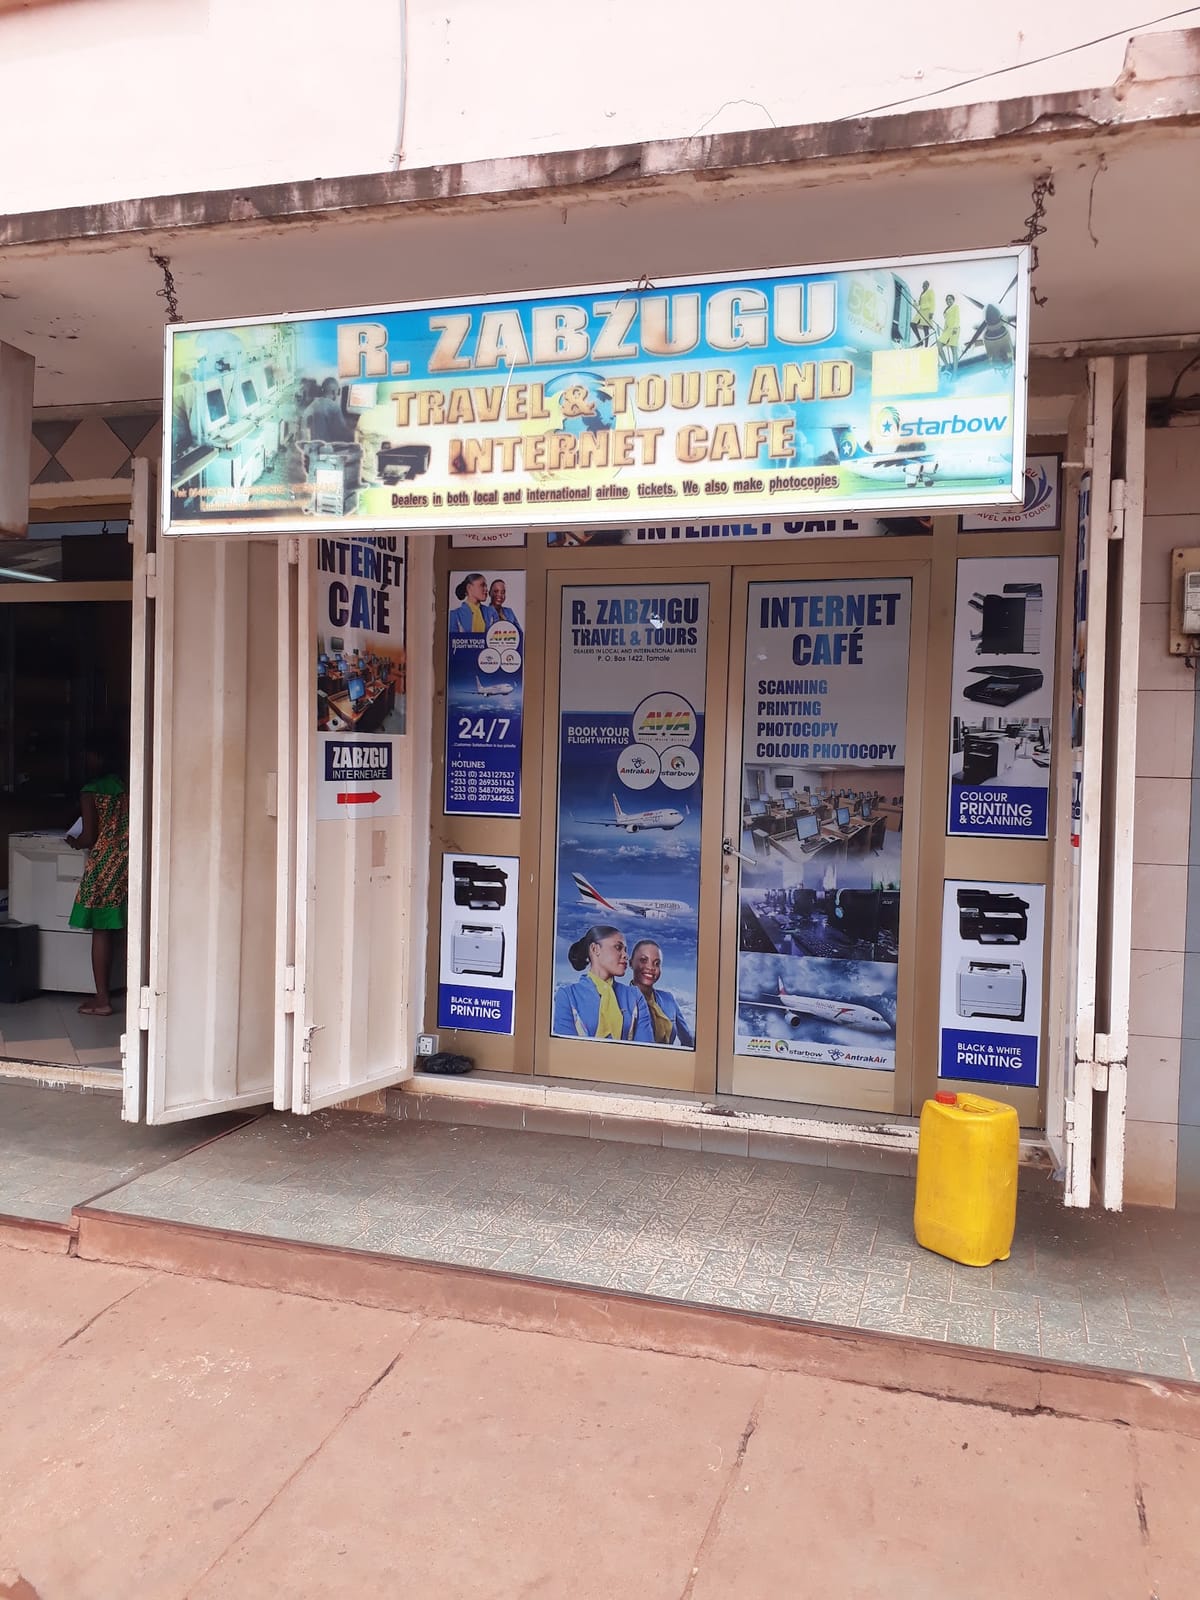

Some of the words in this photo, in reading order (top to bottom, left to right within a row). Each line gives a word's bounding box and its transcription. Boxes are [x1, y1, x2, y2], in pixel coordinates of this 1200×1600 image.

[337, 322, 410, 378] R.
[428, 281, 837, 372] ZABZUGU
[391, 383, 550, 427] TRAVEL
[562, 385, 596, 417] &
[606, 369, 735, 414] TOUR
[748, 360, 853, 404] AND
[900, 415, 1007, 437] starbow
[449, 428, 664, 474] INTERNET
[675, 419, 796, 463] CAFE
[391, 492, 428, 508] Dealers
[432, 492, 442, 506] in
[447, 491, 469, 506] both
[473, 489, 499, 504] local
[503, 488, 522, 502] and
[526, 486, 591, 501] international
[596, 484, 629, 499] airline
[637, 481, 676, 497] tickets.
[682, 479, 700, 494] We
[704, 479, 728, 494] also
[733, 477, 763, 491] make
[769, 473, 839, 495] photocopies
[1024, 502, 1051, 519] TOURS
[317, 538, 403, 587] INTERNET
[329, 581, 390, 635] CAFÉ
[572, 600, 591, 625] R.
[596, 598, 699, 625] ZABZUGU
[760, 593, 901, 628] INTERNET
[572, 628, 625, 646] TRAVEL
[630, 630, 641, 645] &
[645, 627, 698, 646] TOURS
[793, 627, 863, 666] CAFÉ
[758, 680, 828, 695] SCANNING
[757, 701, 821, 716] PRINTING
[459, 718, 510, 742] 24/7
[568, 727, 597, 736] BOOK
[600, 727, 629, 737] YOUR
[757, 722, 838, 737] PHOTOCOPY
[757, 743, 809, 758] COLOUR
[812, 744, 896, 759] PHOTOCOPY
[451, 761, 485, 769] HOTLINES
[960, 792, 1008, 802] COLOUR
[960, 802, 1032, 817] PRINTING
[960, 815, 967, 824] &
[970, 815, 1032, 826] SCANNING
[451, 996, 472, 1004] BLACK
[474, 998, 479, 1006] &
[480, 999, 500, 1007] WHITE
[451, 1005, 501, 1019] PRINTING
[789, 1048, 823, 1057] starbow
[958, 1042, 985, 1052] BLACK
[996, 1046, 1021, 1055] WHITE
[844, 1053, 887, 1064] AntrakAir
[957, 1052, 1022, 1069] PRINTING
